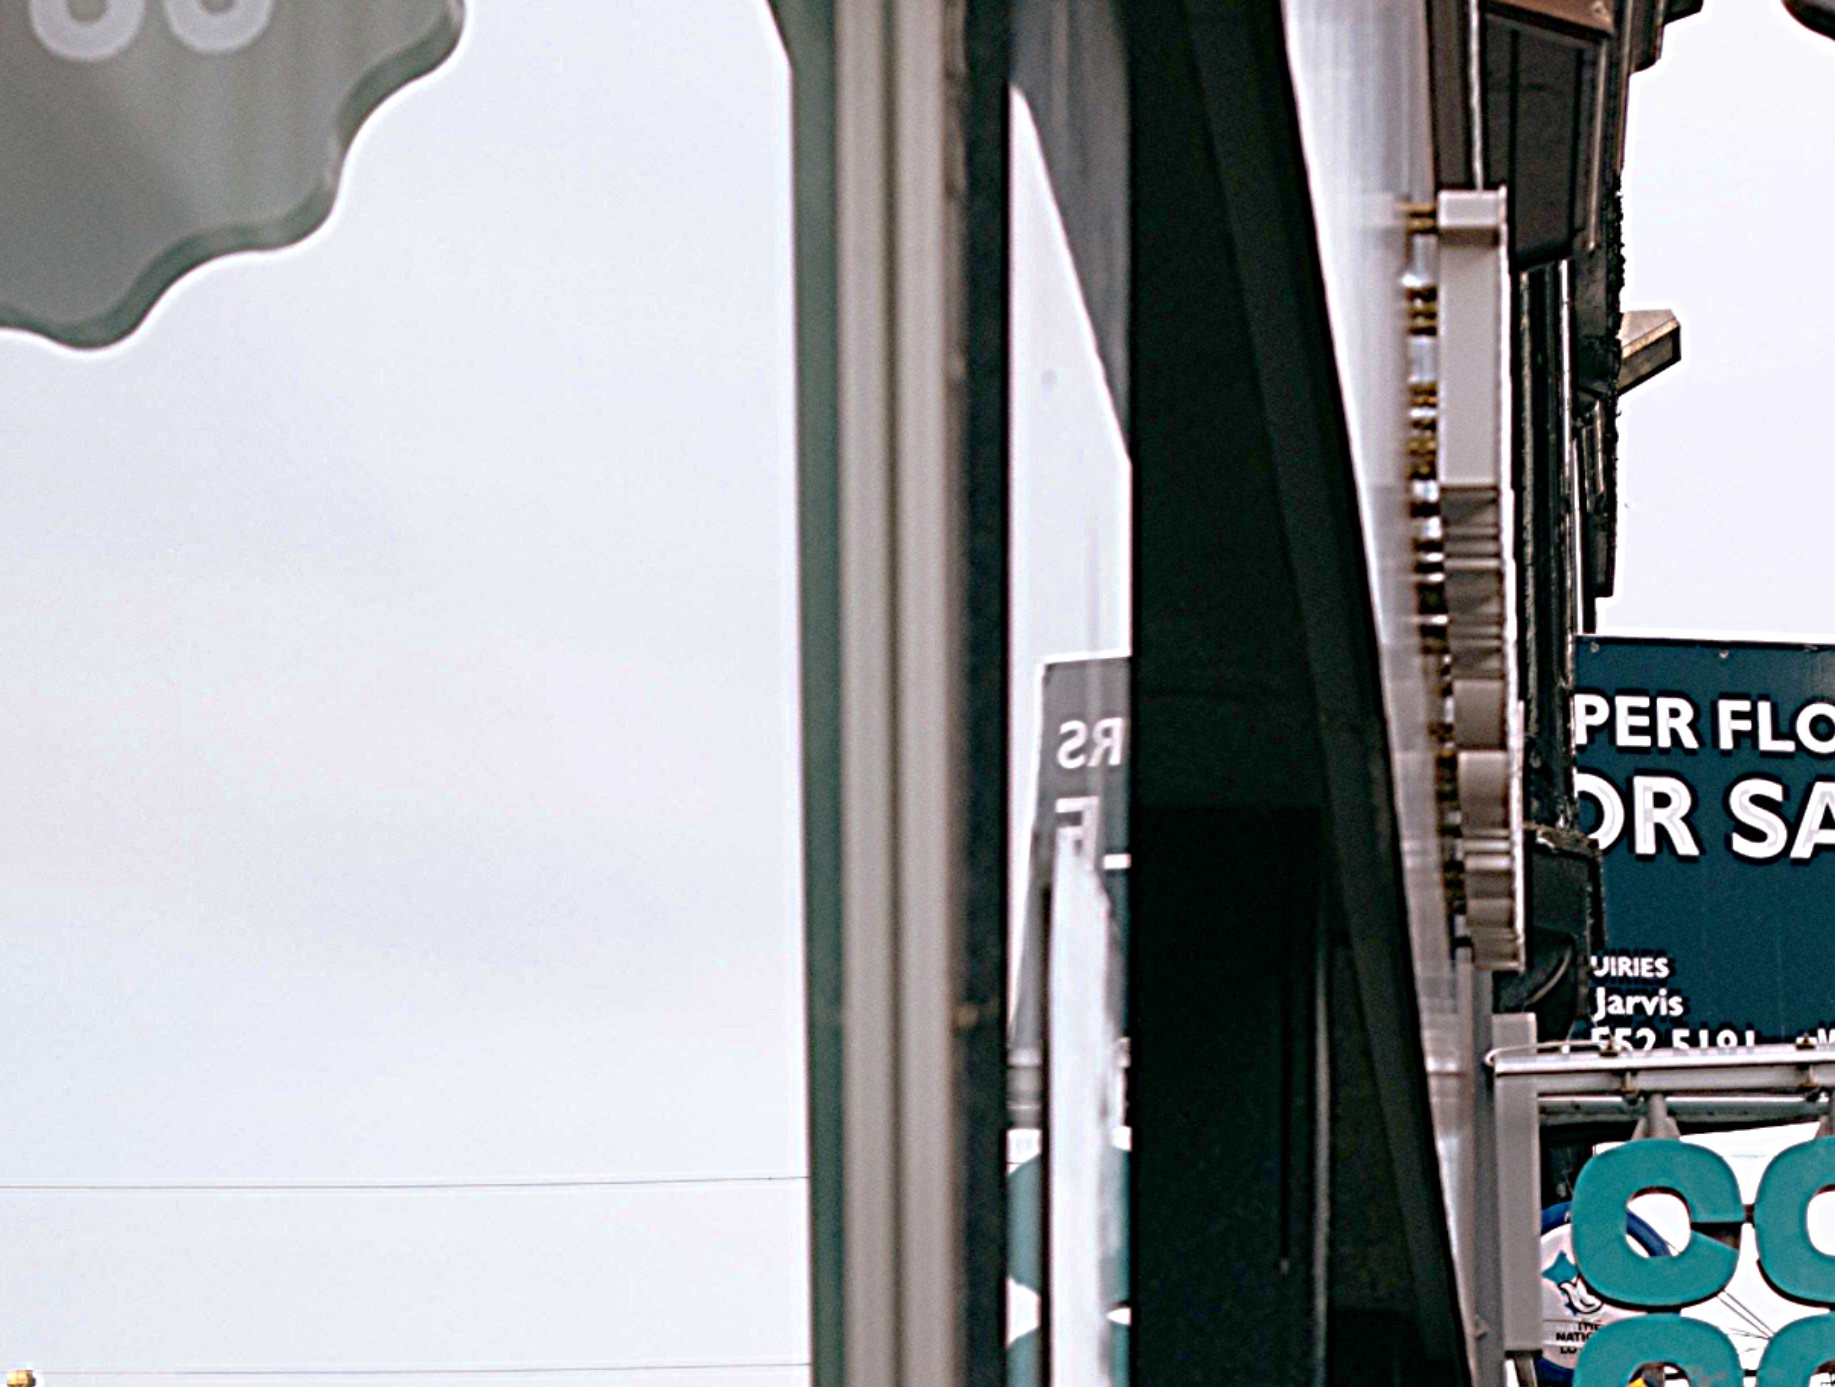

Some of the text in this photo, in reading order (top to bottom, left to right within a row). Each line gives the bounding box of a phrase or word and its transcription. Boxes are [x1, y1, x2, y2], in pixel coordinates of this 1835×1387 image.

[1574, 694, 1699, 749] PER
[1574, 773, 1700, 857] OR
[1591, 955, 1670, 979] UIRIES
[1594, 987, 1684, 1022] Jarvis
